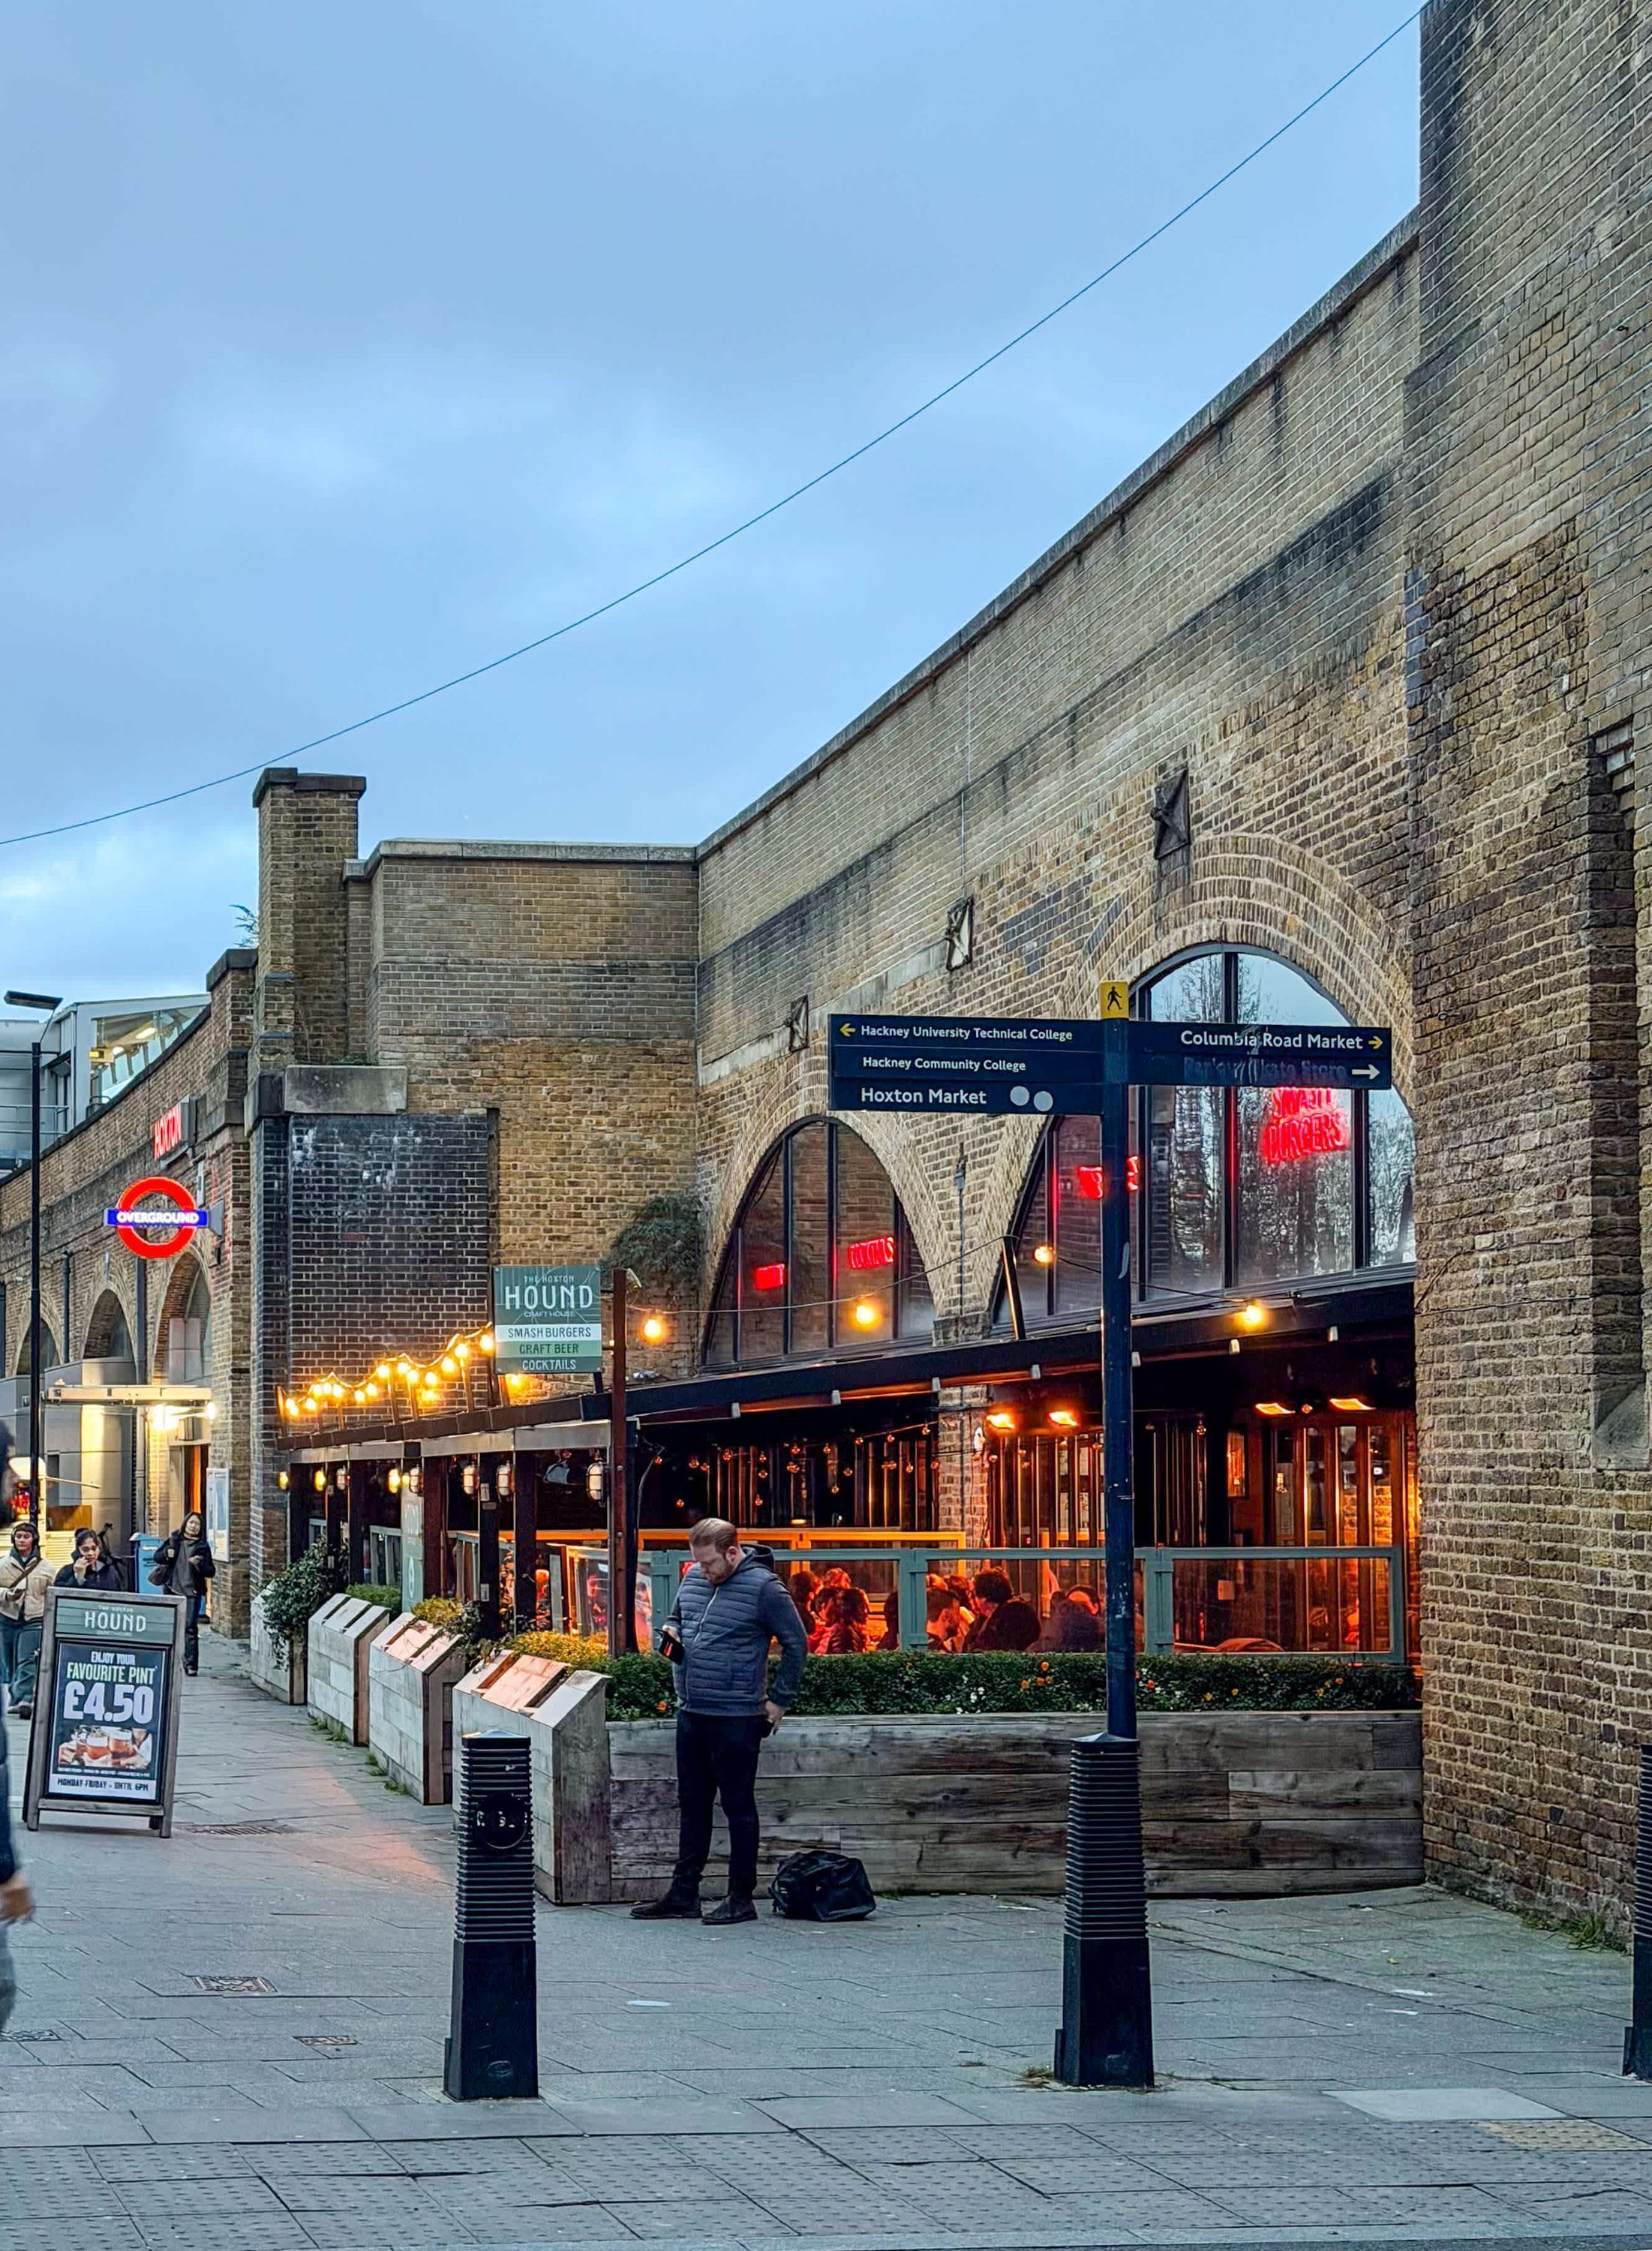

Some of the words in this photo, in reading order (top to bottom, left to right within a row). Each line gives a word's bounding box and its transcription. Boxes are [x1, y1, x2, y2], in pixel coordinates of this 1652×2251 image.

[861, 1025, 909, 1038] Hackney
[913, 1026, 970, 1040] University
[974, 1028, 1027, 1039] Technical
[1030, 1029, 1073, 1041] College
[1180, 1030, 1257, 1048] Columbia
[1263, 1032, 1302, 1047] Road
[1308, 1034, 1363, 1049] Market
[863, 1056, 911, 1070] Hackney
[915, 1058, 980, 1071] Community
[984, 1059, 1026, 1072] College
[861, 1088, 923, 1103] Hoxton
[929, 1089, 987, 1104] Market
[1268, 1107, 1345, 1162] BURGERS
[116, 1212, 199, 1224] OVERGROUND
[542, 1275, 575, 1283] HOXTON
[505, 1285, 593, 1309] HOUND
[508, 1327, 543, 1339] SMASH
[545, 1327, 591, 1338] BURGERS
[519, 1344, 551, 1354] CRAFT
[554, 1343, 579, 1354] BEER
[522, 1360, 576, 1371] COCKTAILS
[85, 1611, 146, 1632] HOUND
[91, 1651, 115, 1664] ENJOY
[116, 1653, 135, 1665] YOUR
[67, 1662, 125, 1682] FAVOURITE
[63, 1681, 154, 1724] £4.50
